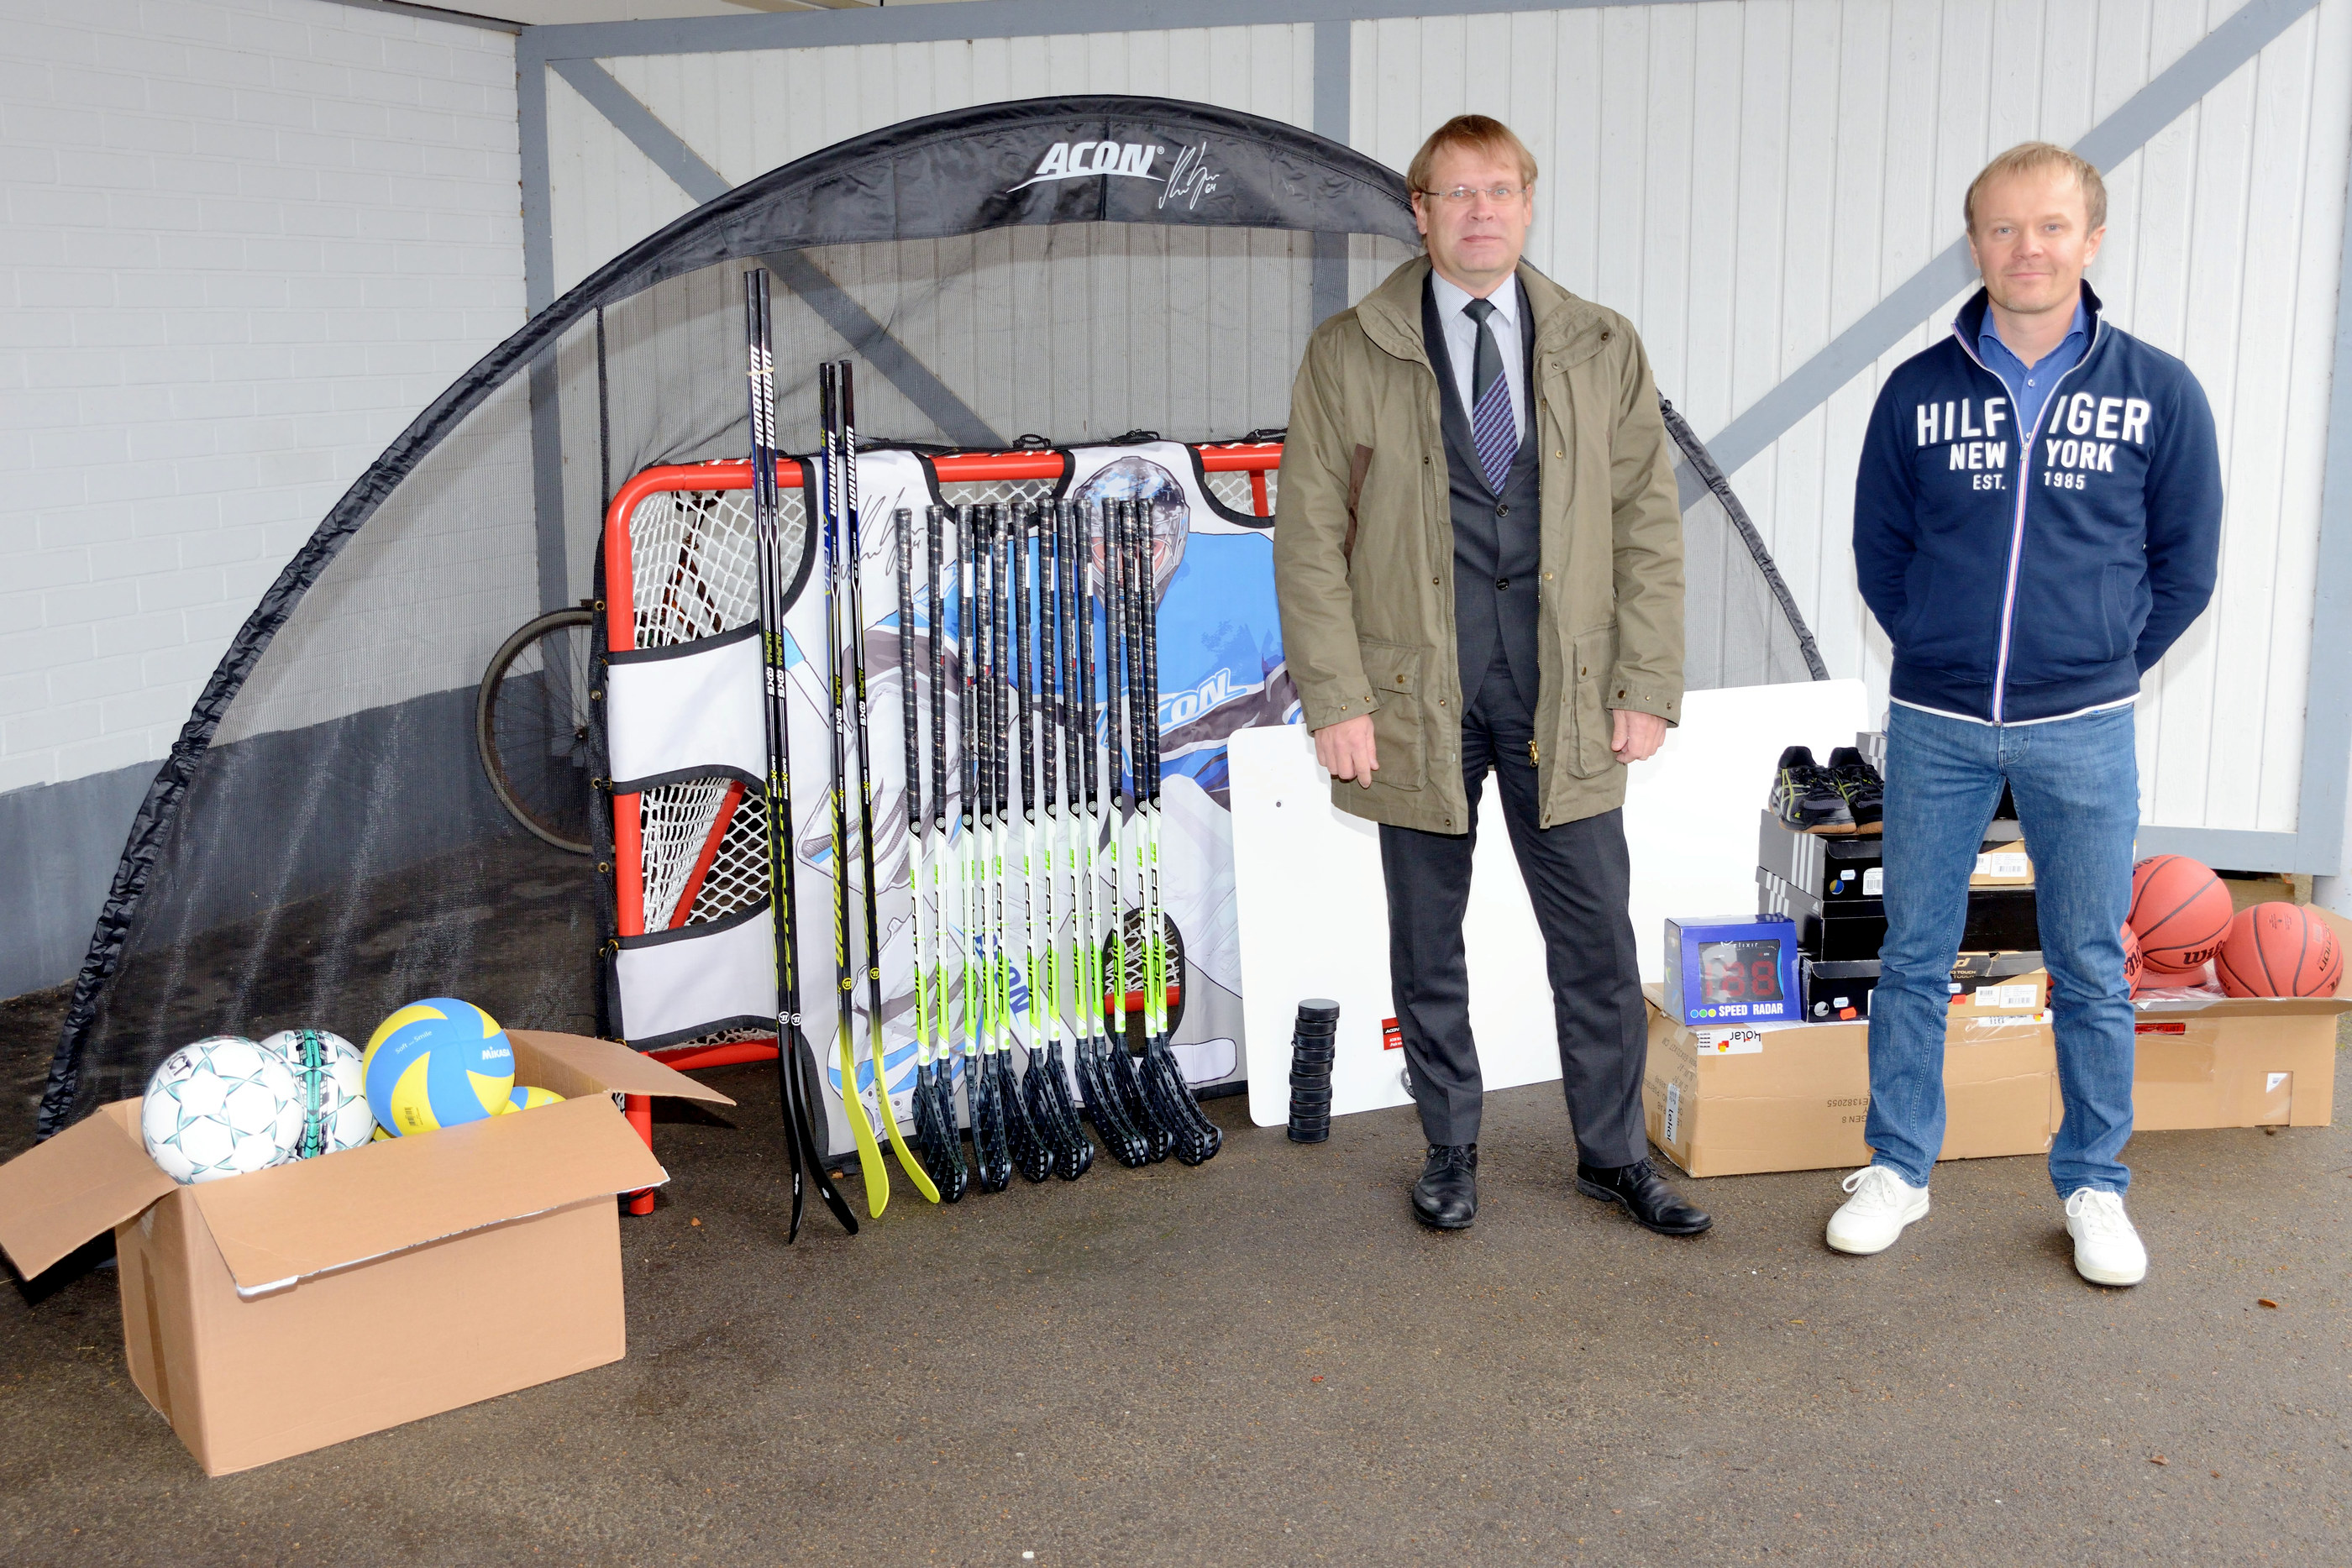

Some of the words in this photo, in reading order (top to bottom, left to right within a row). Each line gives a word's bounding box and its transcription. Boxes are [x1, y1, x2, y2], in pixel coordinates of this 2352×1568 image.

[846, 425, 857, 511] WARRIOR
[1949, 441, 2007, 470] NEW
[2045, 440, 2114, 472] YORK
[828, 431, 837, 517] WARRIOR
[1972, 474, 2006, 490] EST.
[2044, 472, 2085, 490] 1985
[1719, 1004, 1747, 1017] SPEED
[1753, 1003, 1783, 1015] RADAR
[413, 1030, 433, 1042] Smile
